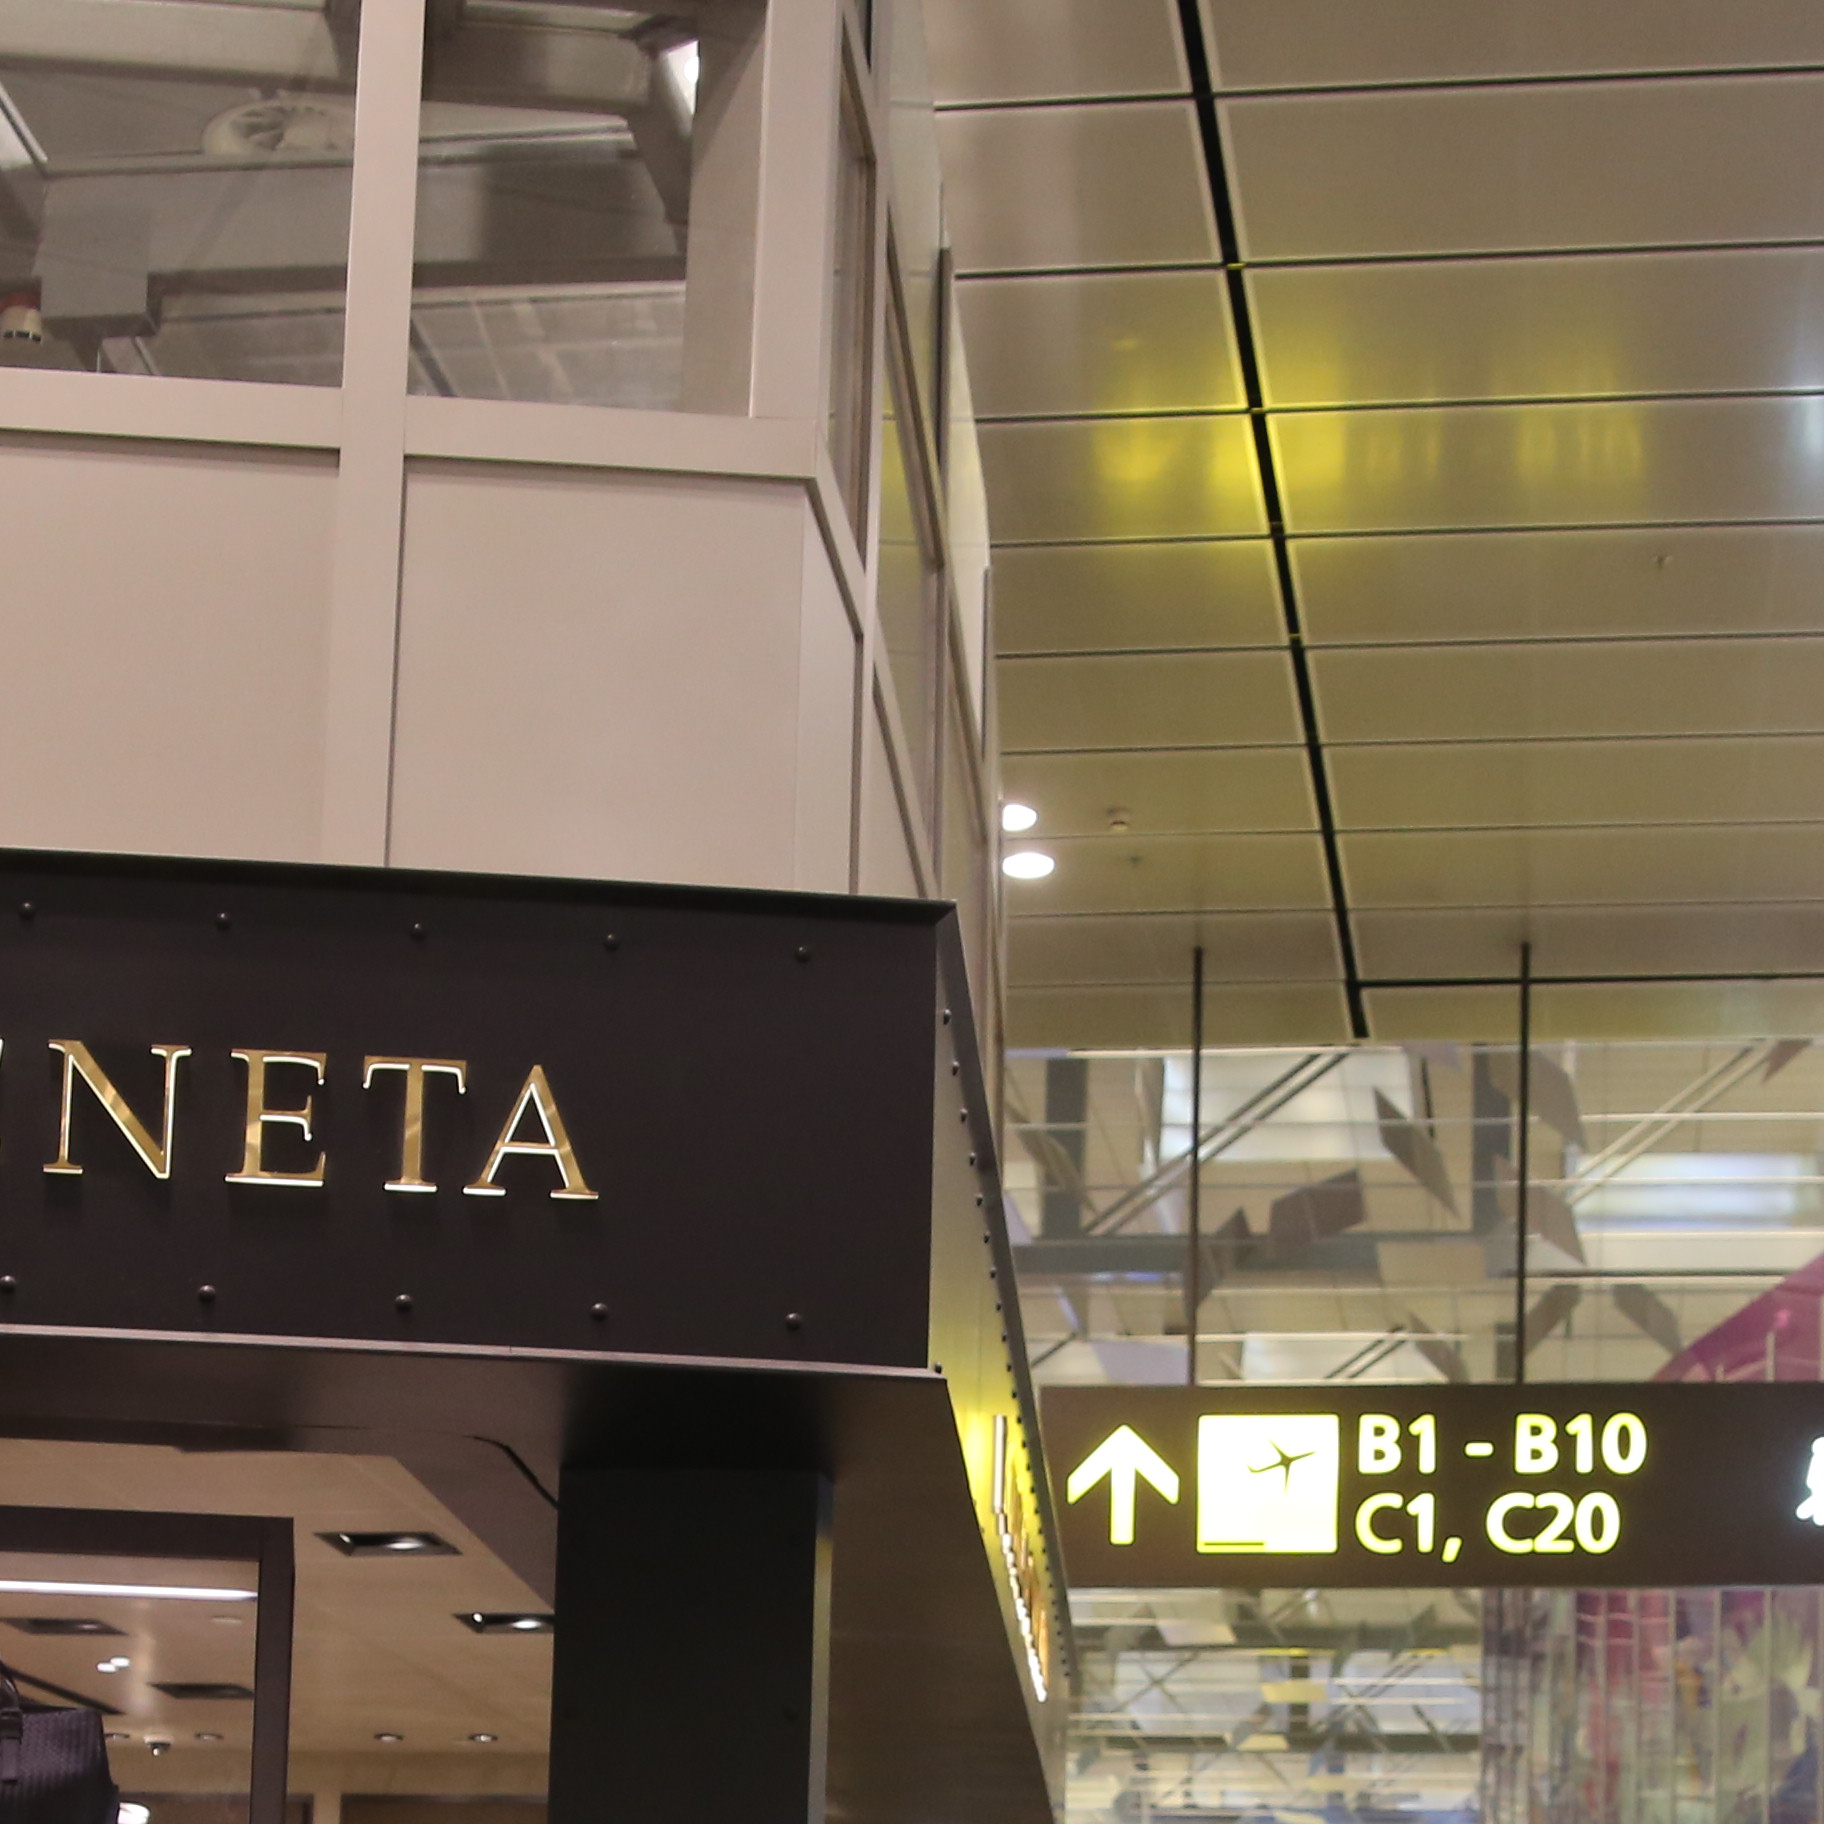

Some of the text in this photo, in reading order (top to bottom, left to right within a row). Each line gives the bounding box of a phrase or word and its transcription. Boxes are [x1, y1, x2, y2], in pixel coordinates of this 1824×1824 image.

[1358, 1411, 1647, 1475] B1 - B10
[1355, 1491, 1621, 1563] C1, C20
